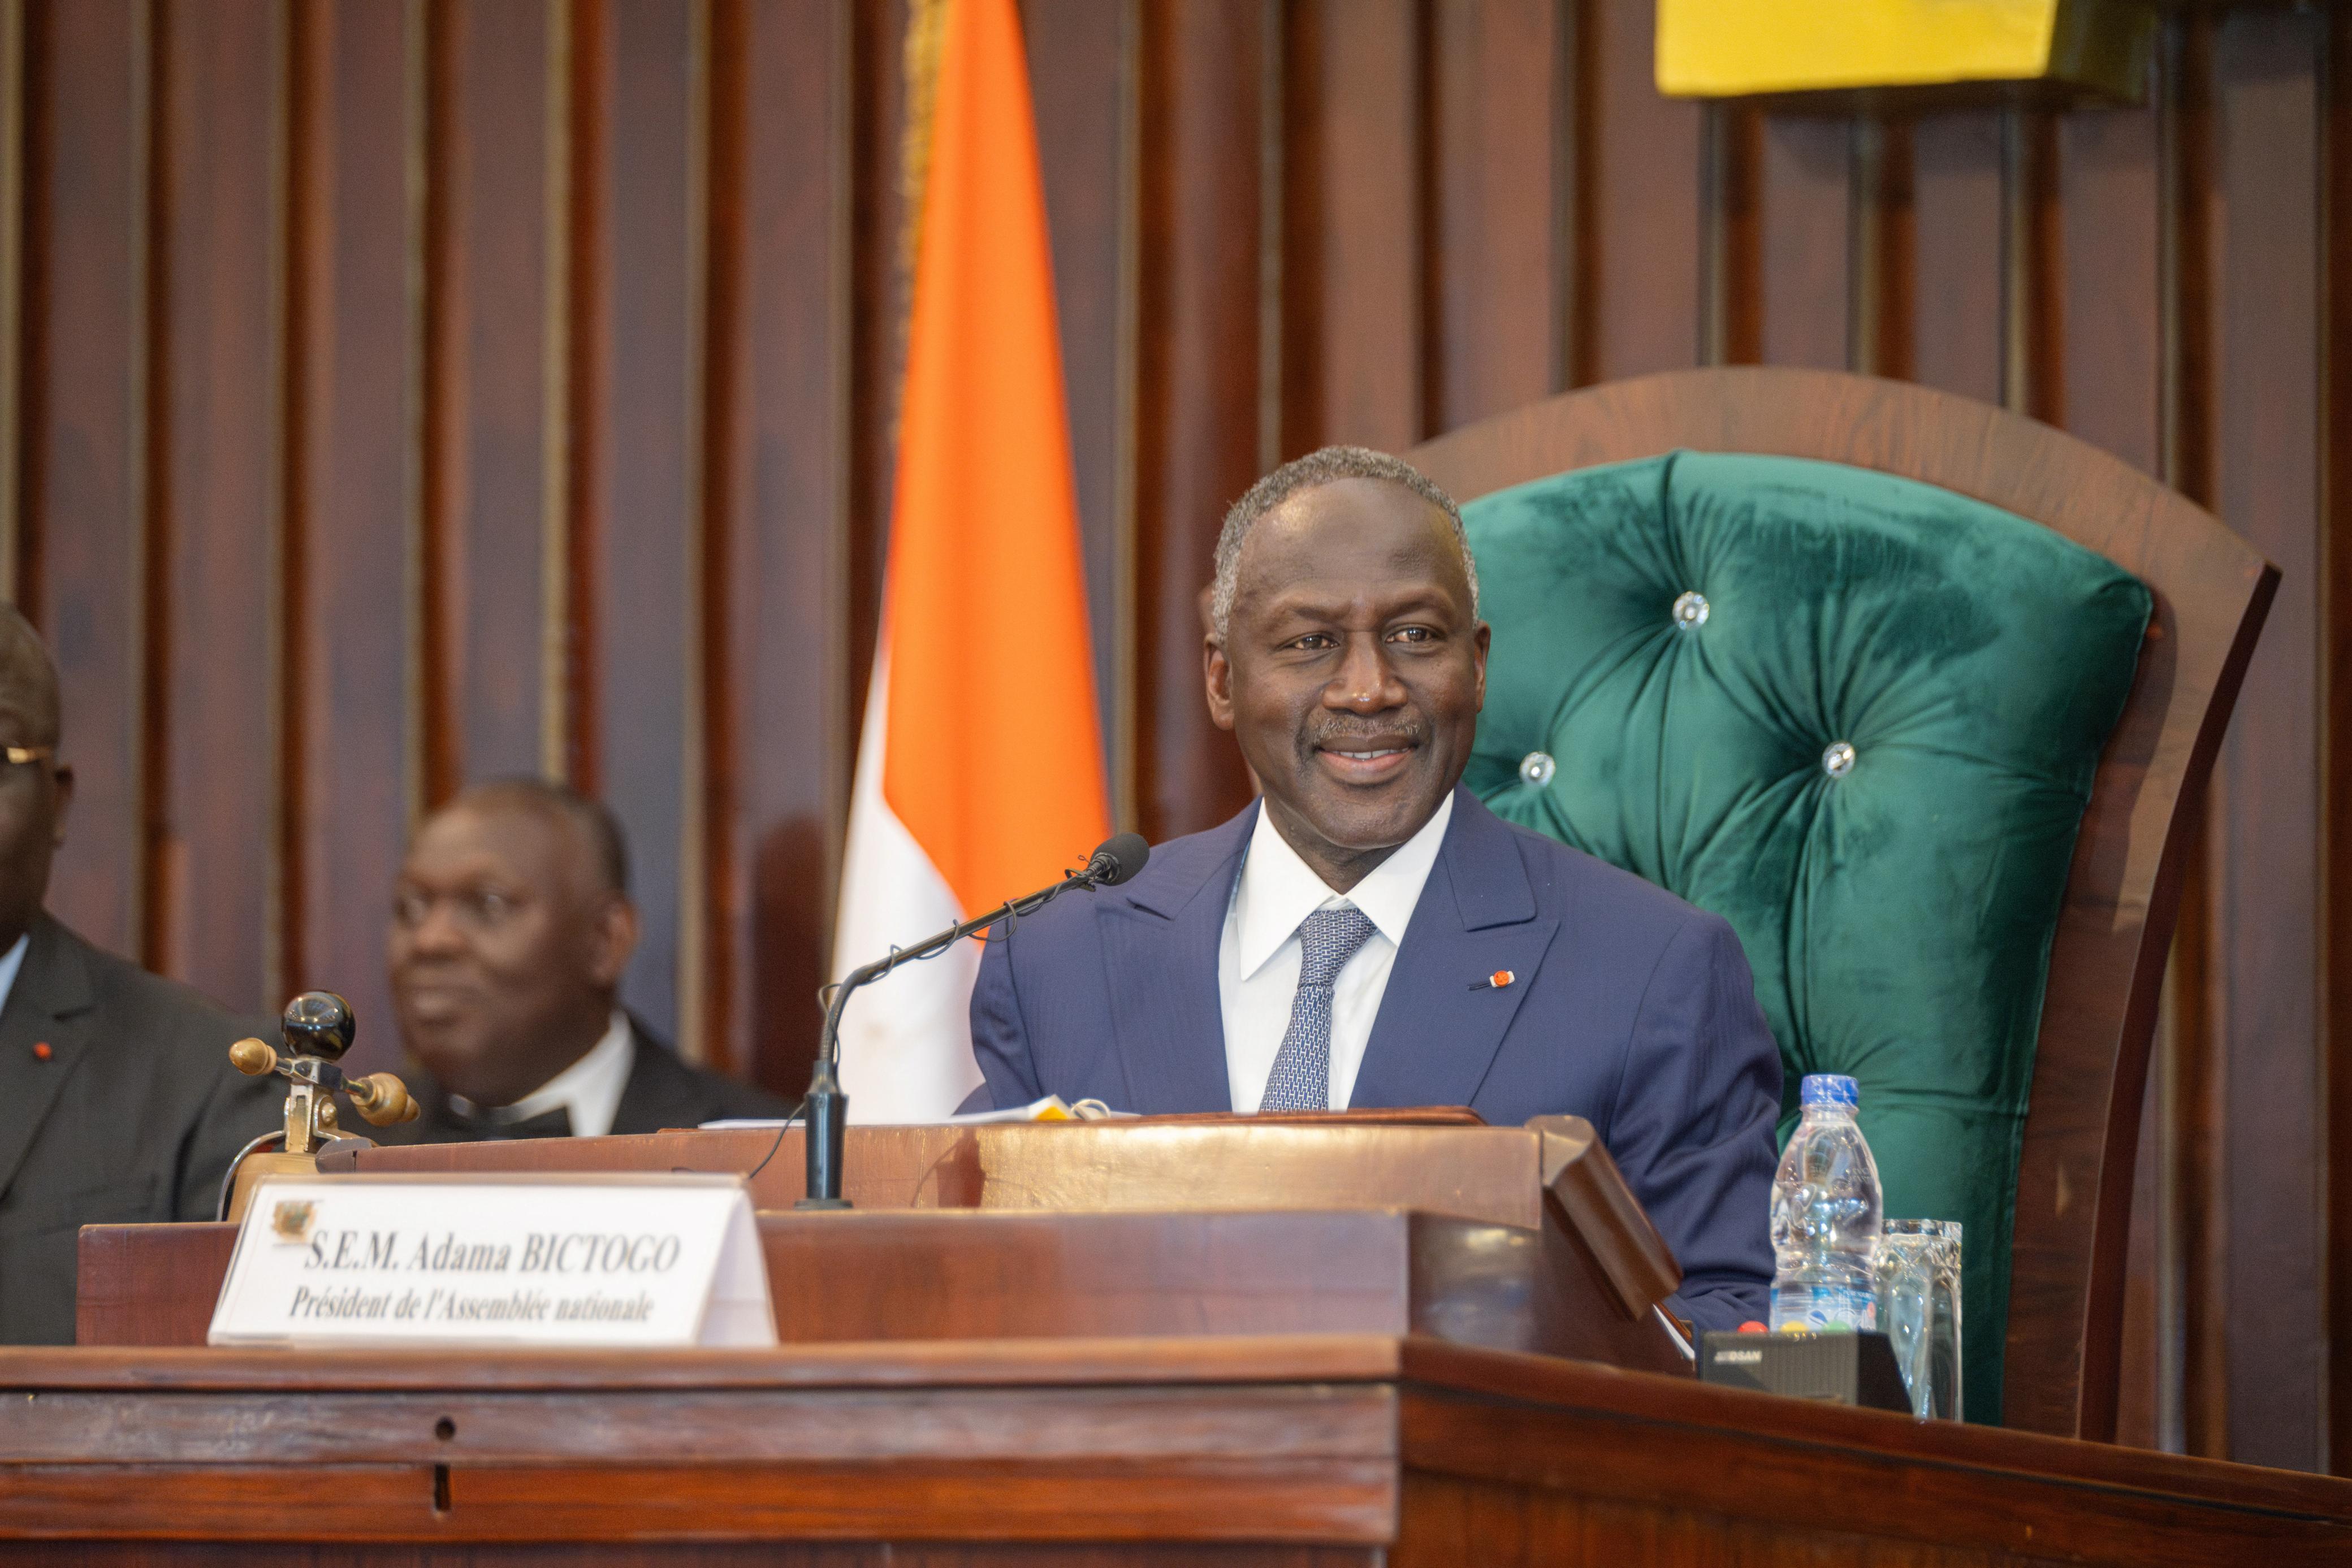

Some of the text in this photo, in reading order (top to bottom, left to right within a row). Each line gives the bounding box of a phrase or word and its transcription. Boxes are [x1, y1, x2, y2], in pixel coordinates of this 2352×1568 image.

[305, 1230, 681, 1273] S.E.M. Adama BICTOGO
[289, 1285, 654, 1322] Président de l'Assemblée nationale
